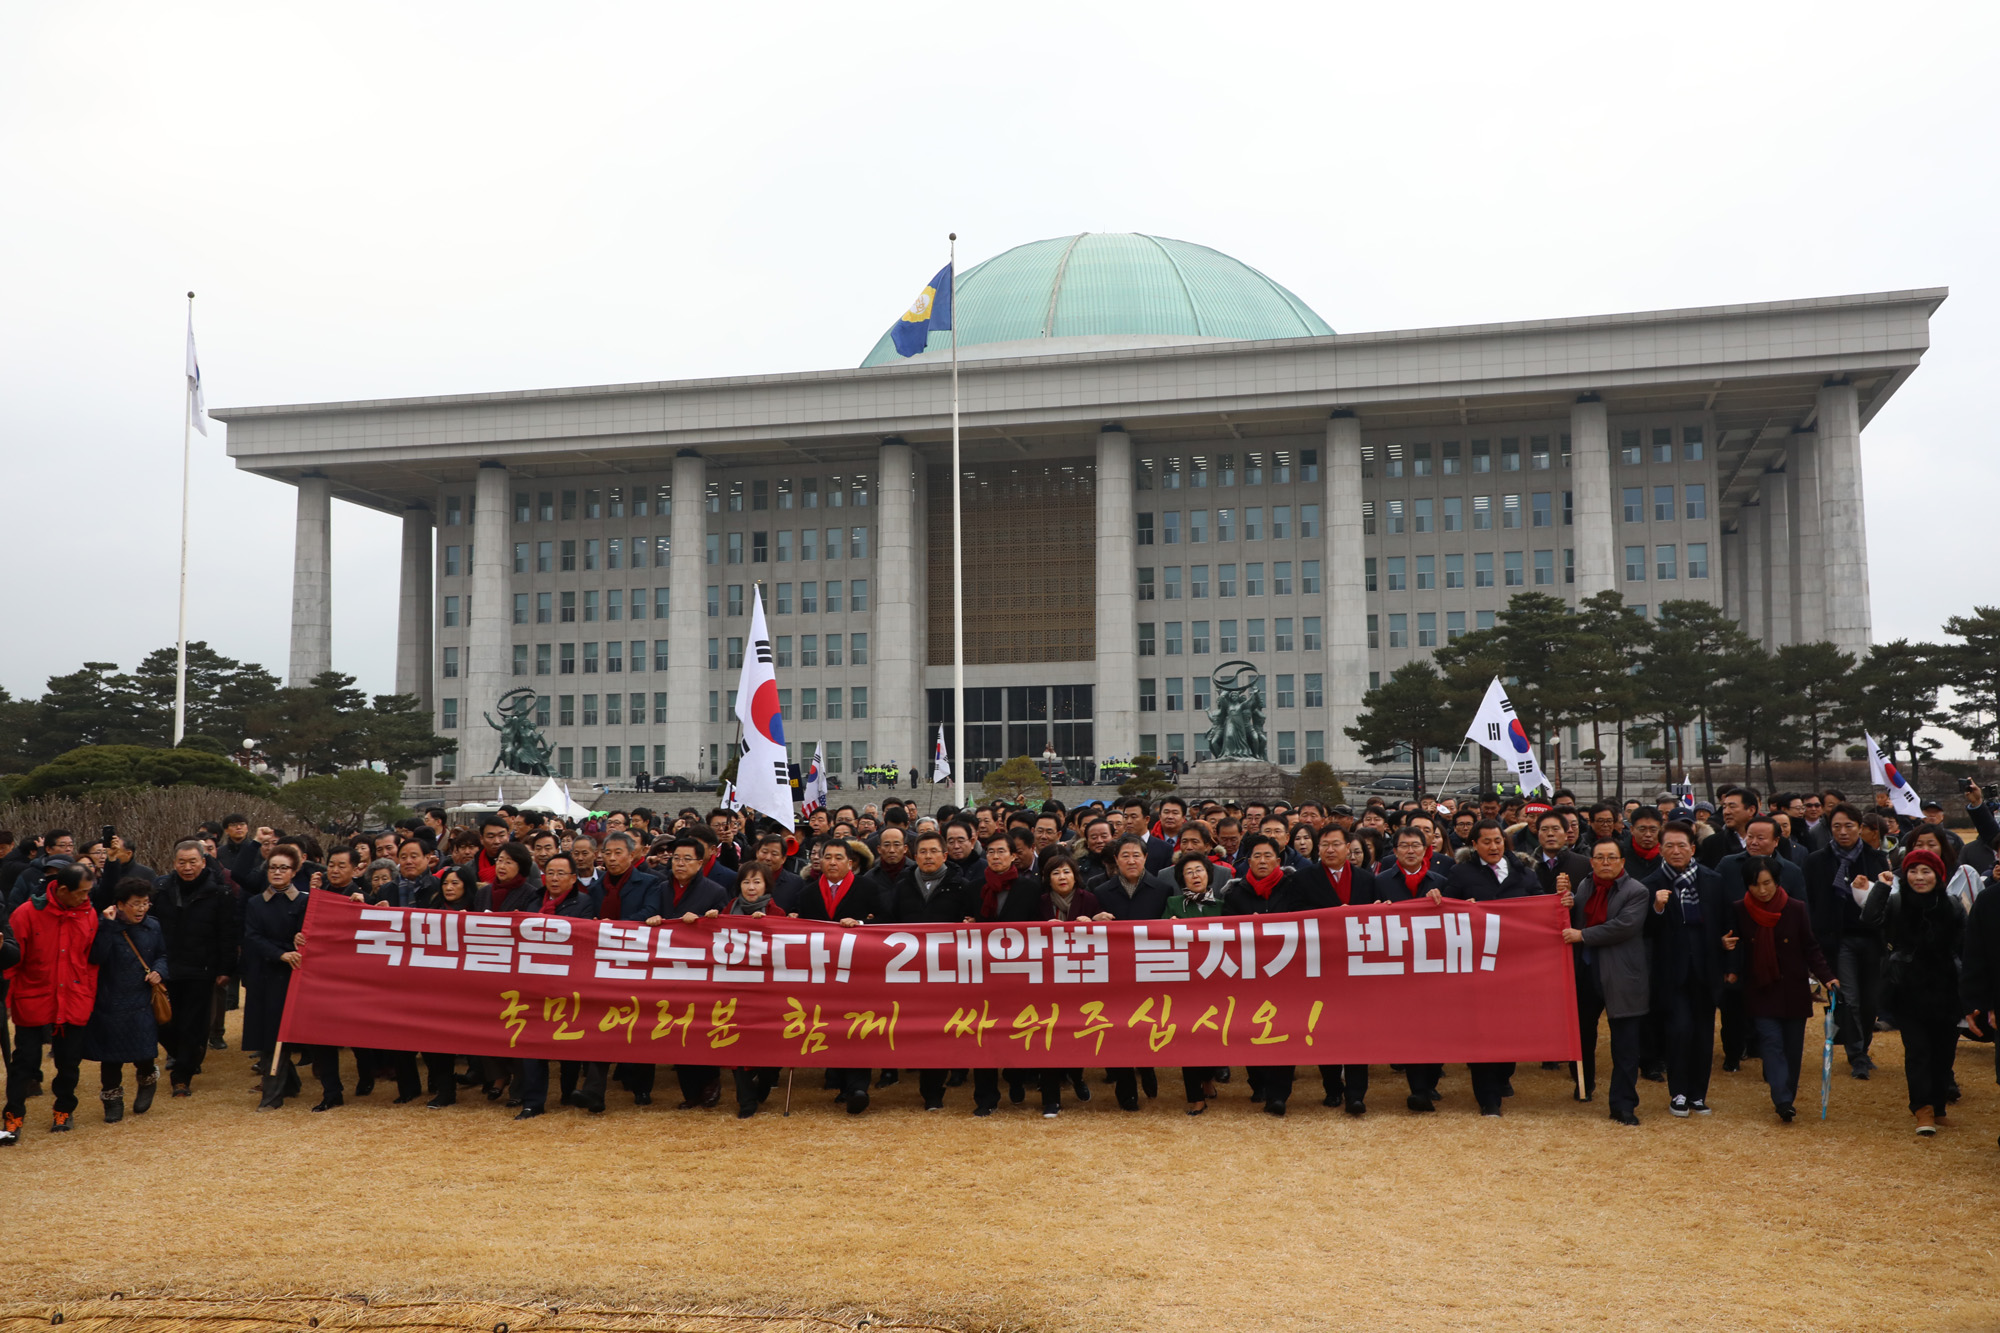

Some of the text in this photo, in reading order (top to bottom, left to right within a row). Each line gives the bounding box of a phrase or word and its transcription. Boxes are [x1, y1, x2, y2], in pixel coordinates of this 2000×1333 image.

[354, 909, 1502, 984] 국민들은 분노한다! 2대악법 날치기 반대!
[500, 990, 1324, 1056] 국민여러분 함께 싸워주십시오!
